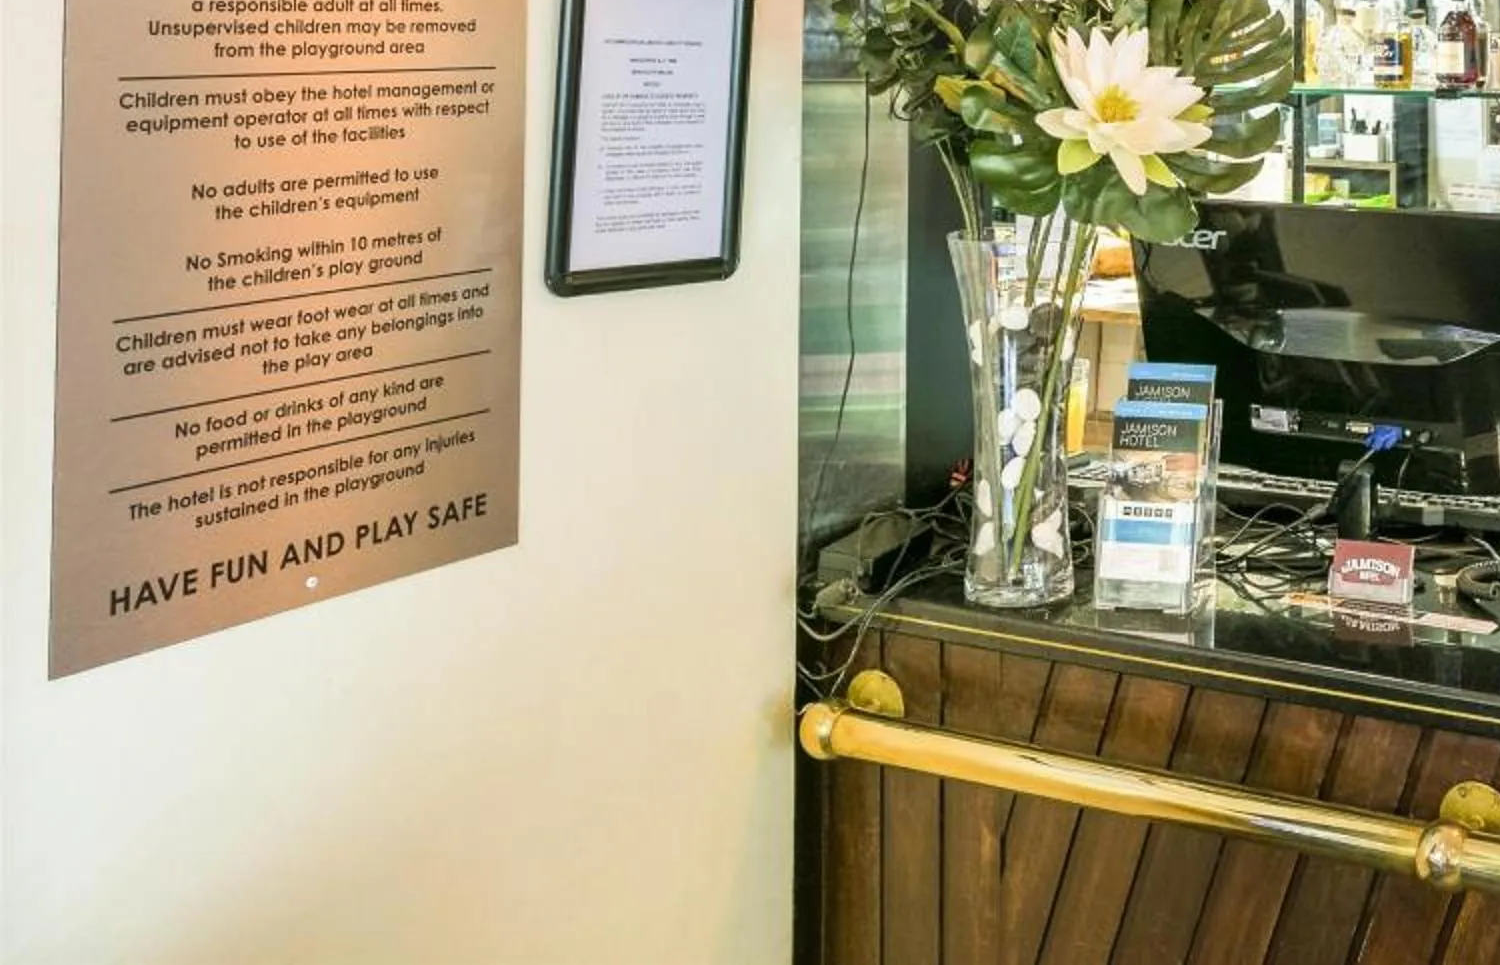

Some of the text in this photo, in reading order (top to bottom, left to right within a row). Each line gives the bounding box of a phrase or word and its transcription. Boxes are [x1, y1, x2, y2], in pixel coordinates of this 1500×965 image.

[191, 0, 205, 13] a
[148, 18, 477, 40] Unsupervised children may be removed
[214, 39, 425, 60] from the playground area
[119, 79, 495, 110] Children must obey the hotel management or
[125, 98, 490, 136] equipment operator at all times with respect
[233, 124, 406, 150] to use of the facilities
[191, 167, 439, 200] No adults are permitted to use
[215, 186, 420, 220] the children's equipment
[185, 226, 442, 272] No Smoking within 10 metres of
[1170, 229, 1228, 250] cer
[207, 249, 423, 292] the children's play ground
[115, 282, 490, 353] Children must wear foot wear at all times and
[123, 304, 484, 376] are advised not to take any belongings into
[261, 345, 373, 376] the play area
[175, 375, 445, 439] No food or drinks of any kind are
[1135, 386, 1191, 399] JAMISON
[195, 395, 427, 462] permitted in the playground
[1119, 435, 1160, 448] HOTEL
[1120, 423, 1178, 437] JAMISON
[128, 430, 476, 521] The hotel is not responsible for any injuries
[194, 459, 425, 529] sustained in the playground
[109, 492, 487, 617] HAVE FUN AND PLAY SAFE
[1341, 558, 1401, 578] JAMISON
